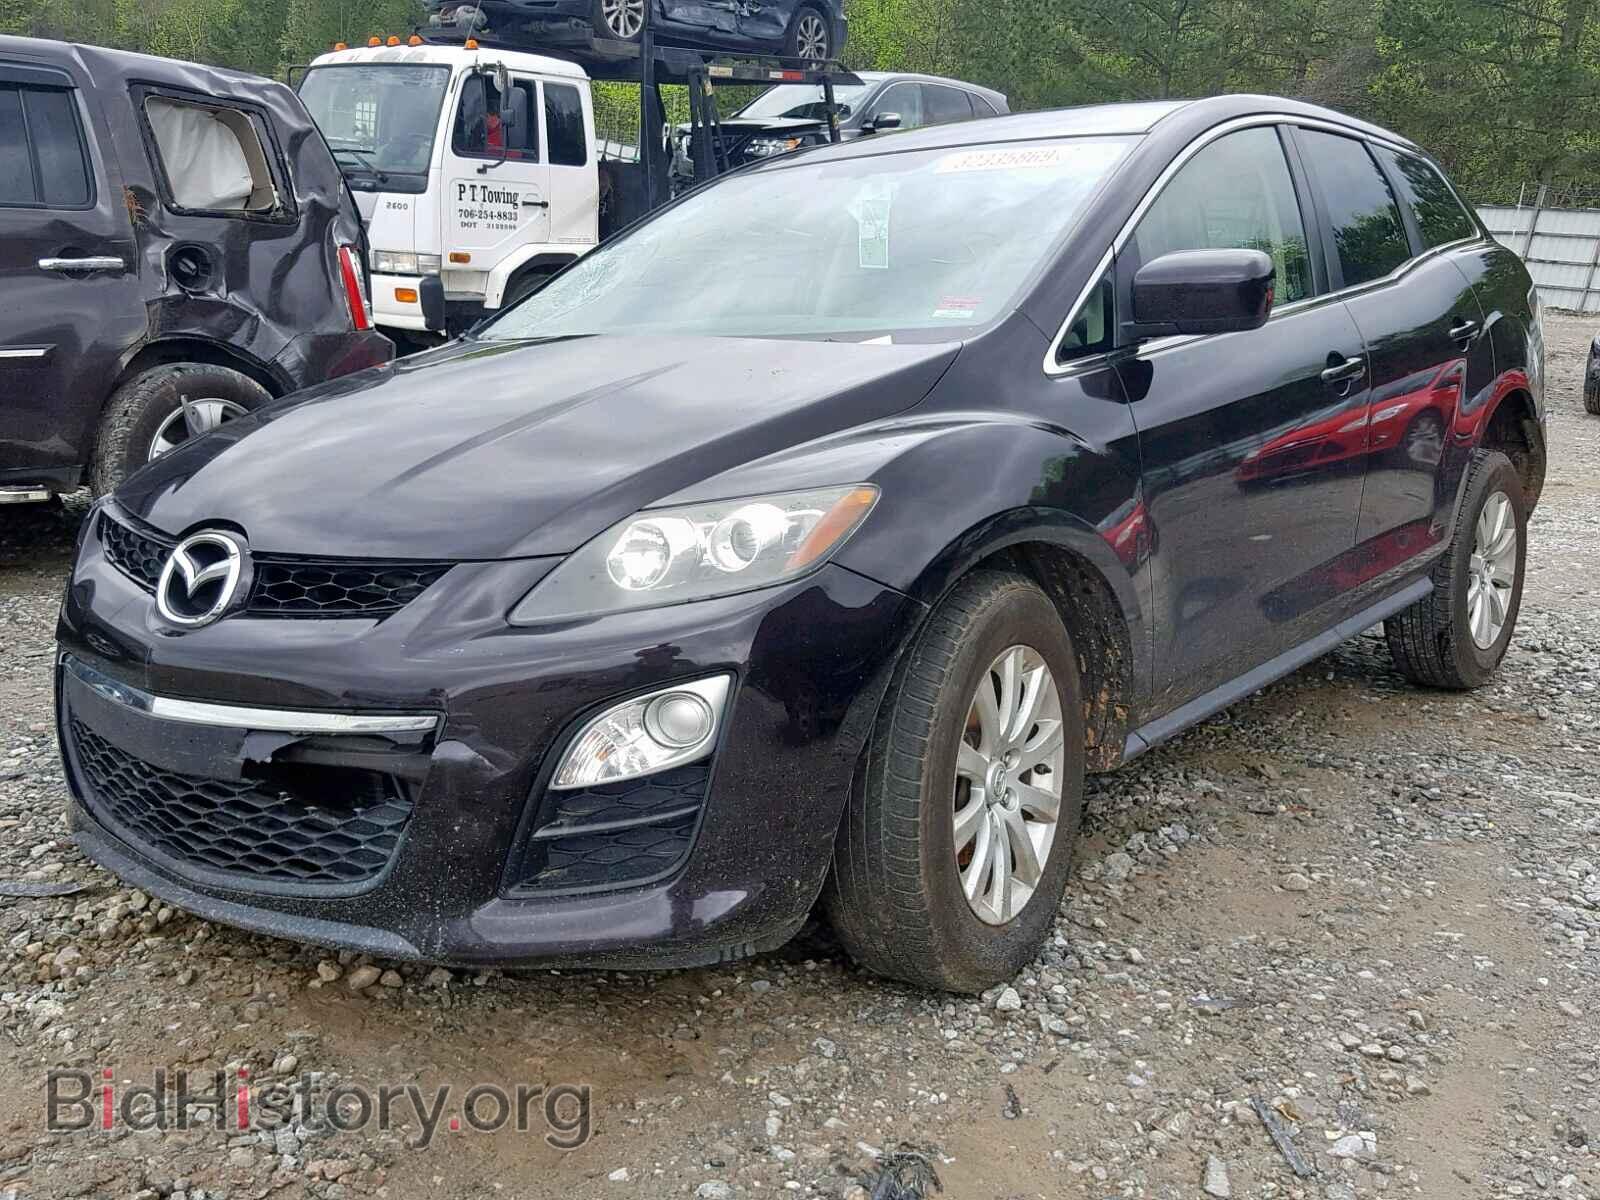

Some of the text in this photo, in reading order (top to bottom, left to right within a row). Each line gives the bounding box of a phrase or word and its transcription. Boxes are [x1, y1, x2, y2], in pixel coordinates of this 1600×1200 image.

[457, 183, 519, 209] P T Towing
[458, 208, 518, 221] 706-254-8833
[460, 221, 477, 229] DOT
